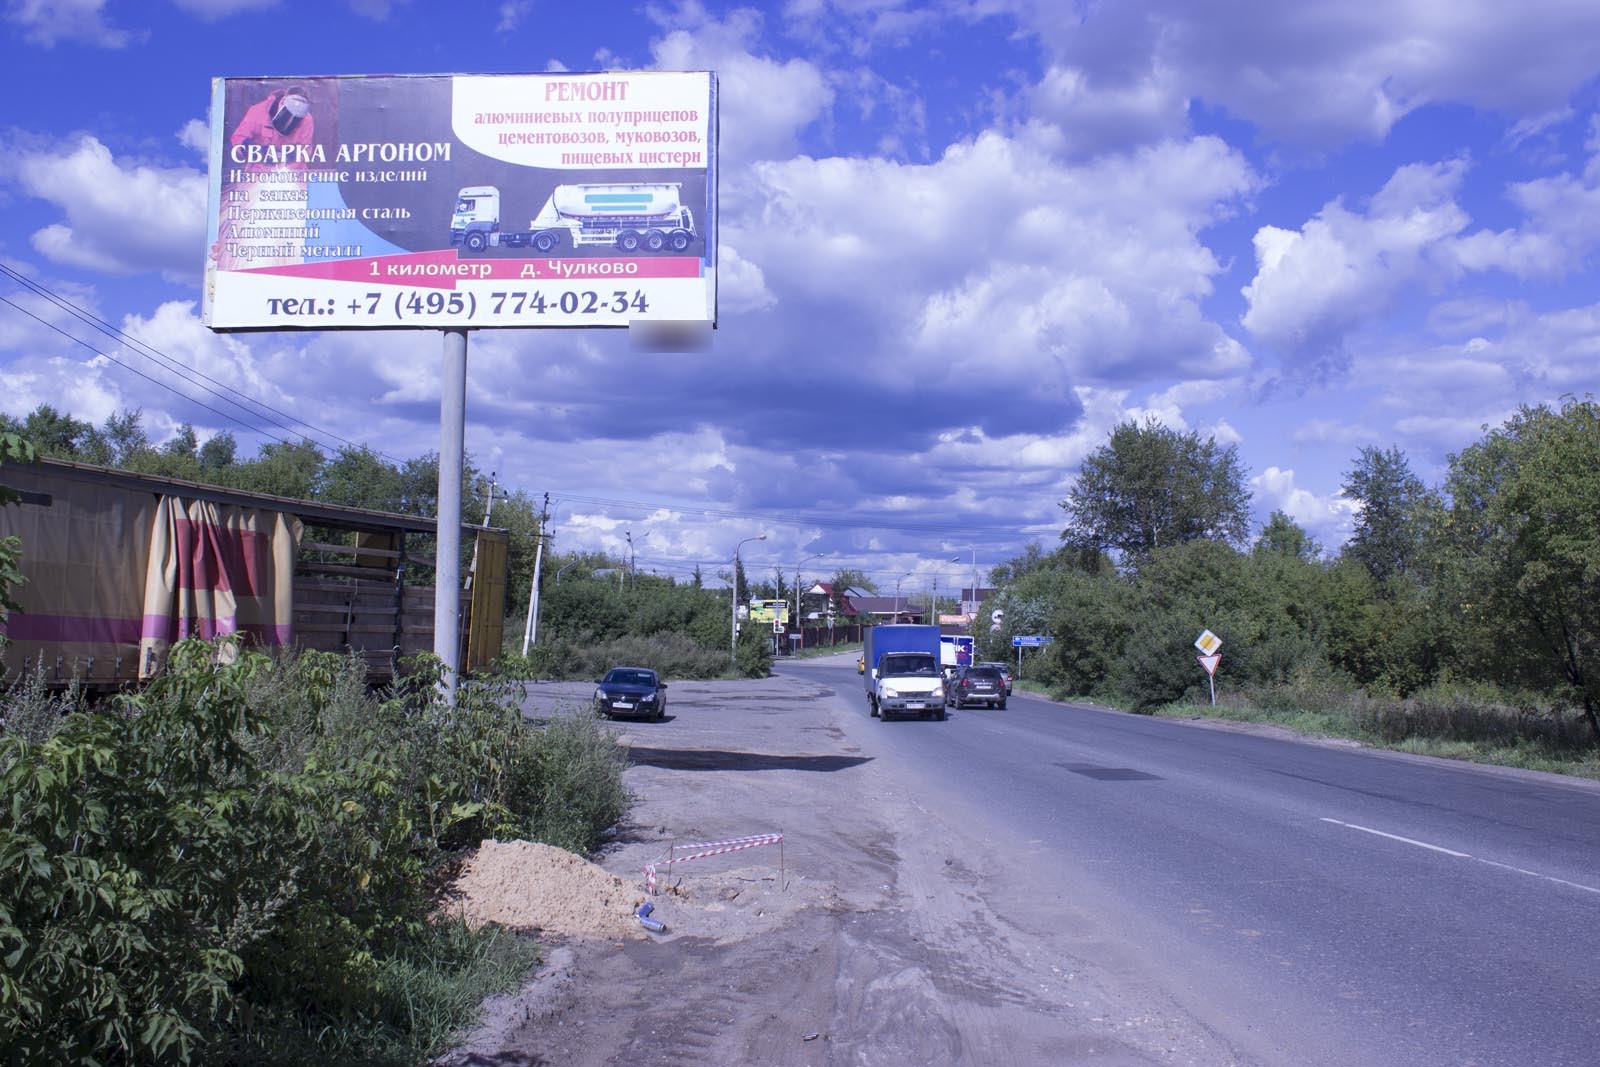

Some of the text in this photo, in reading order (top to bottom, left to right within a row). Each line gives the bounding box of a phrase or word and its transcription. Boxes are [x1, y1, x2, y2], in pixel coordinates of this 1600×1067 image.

[545, 82, 629, 102] РЕМОНТ
[474, 110, 699, 126] алюминиевых полуприцепов
[498, 131, 702, 146] цементовозов, муковозов,
[230, 142, 451, 163] СВАРКА АРГОНОМ
[561, 151, 701, 167] пищевых цистерн
[229, 168, 428, 184] Изготовление изделий
[229, 189, 309, 202] на заказ
[227, 206, 412, 223] Нержавеющая сталь
[226, 224, 321, 239] Алюминий
[225, 242, 362, 260] Черный металл
[369, 260, 639, 280] 1 километр д. Чулково
[267, 288, 650, 320] тел.: +7 (495) 774-02-34
